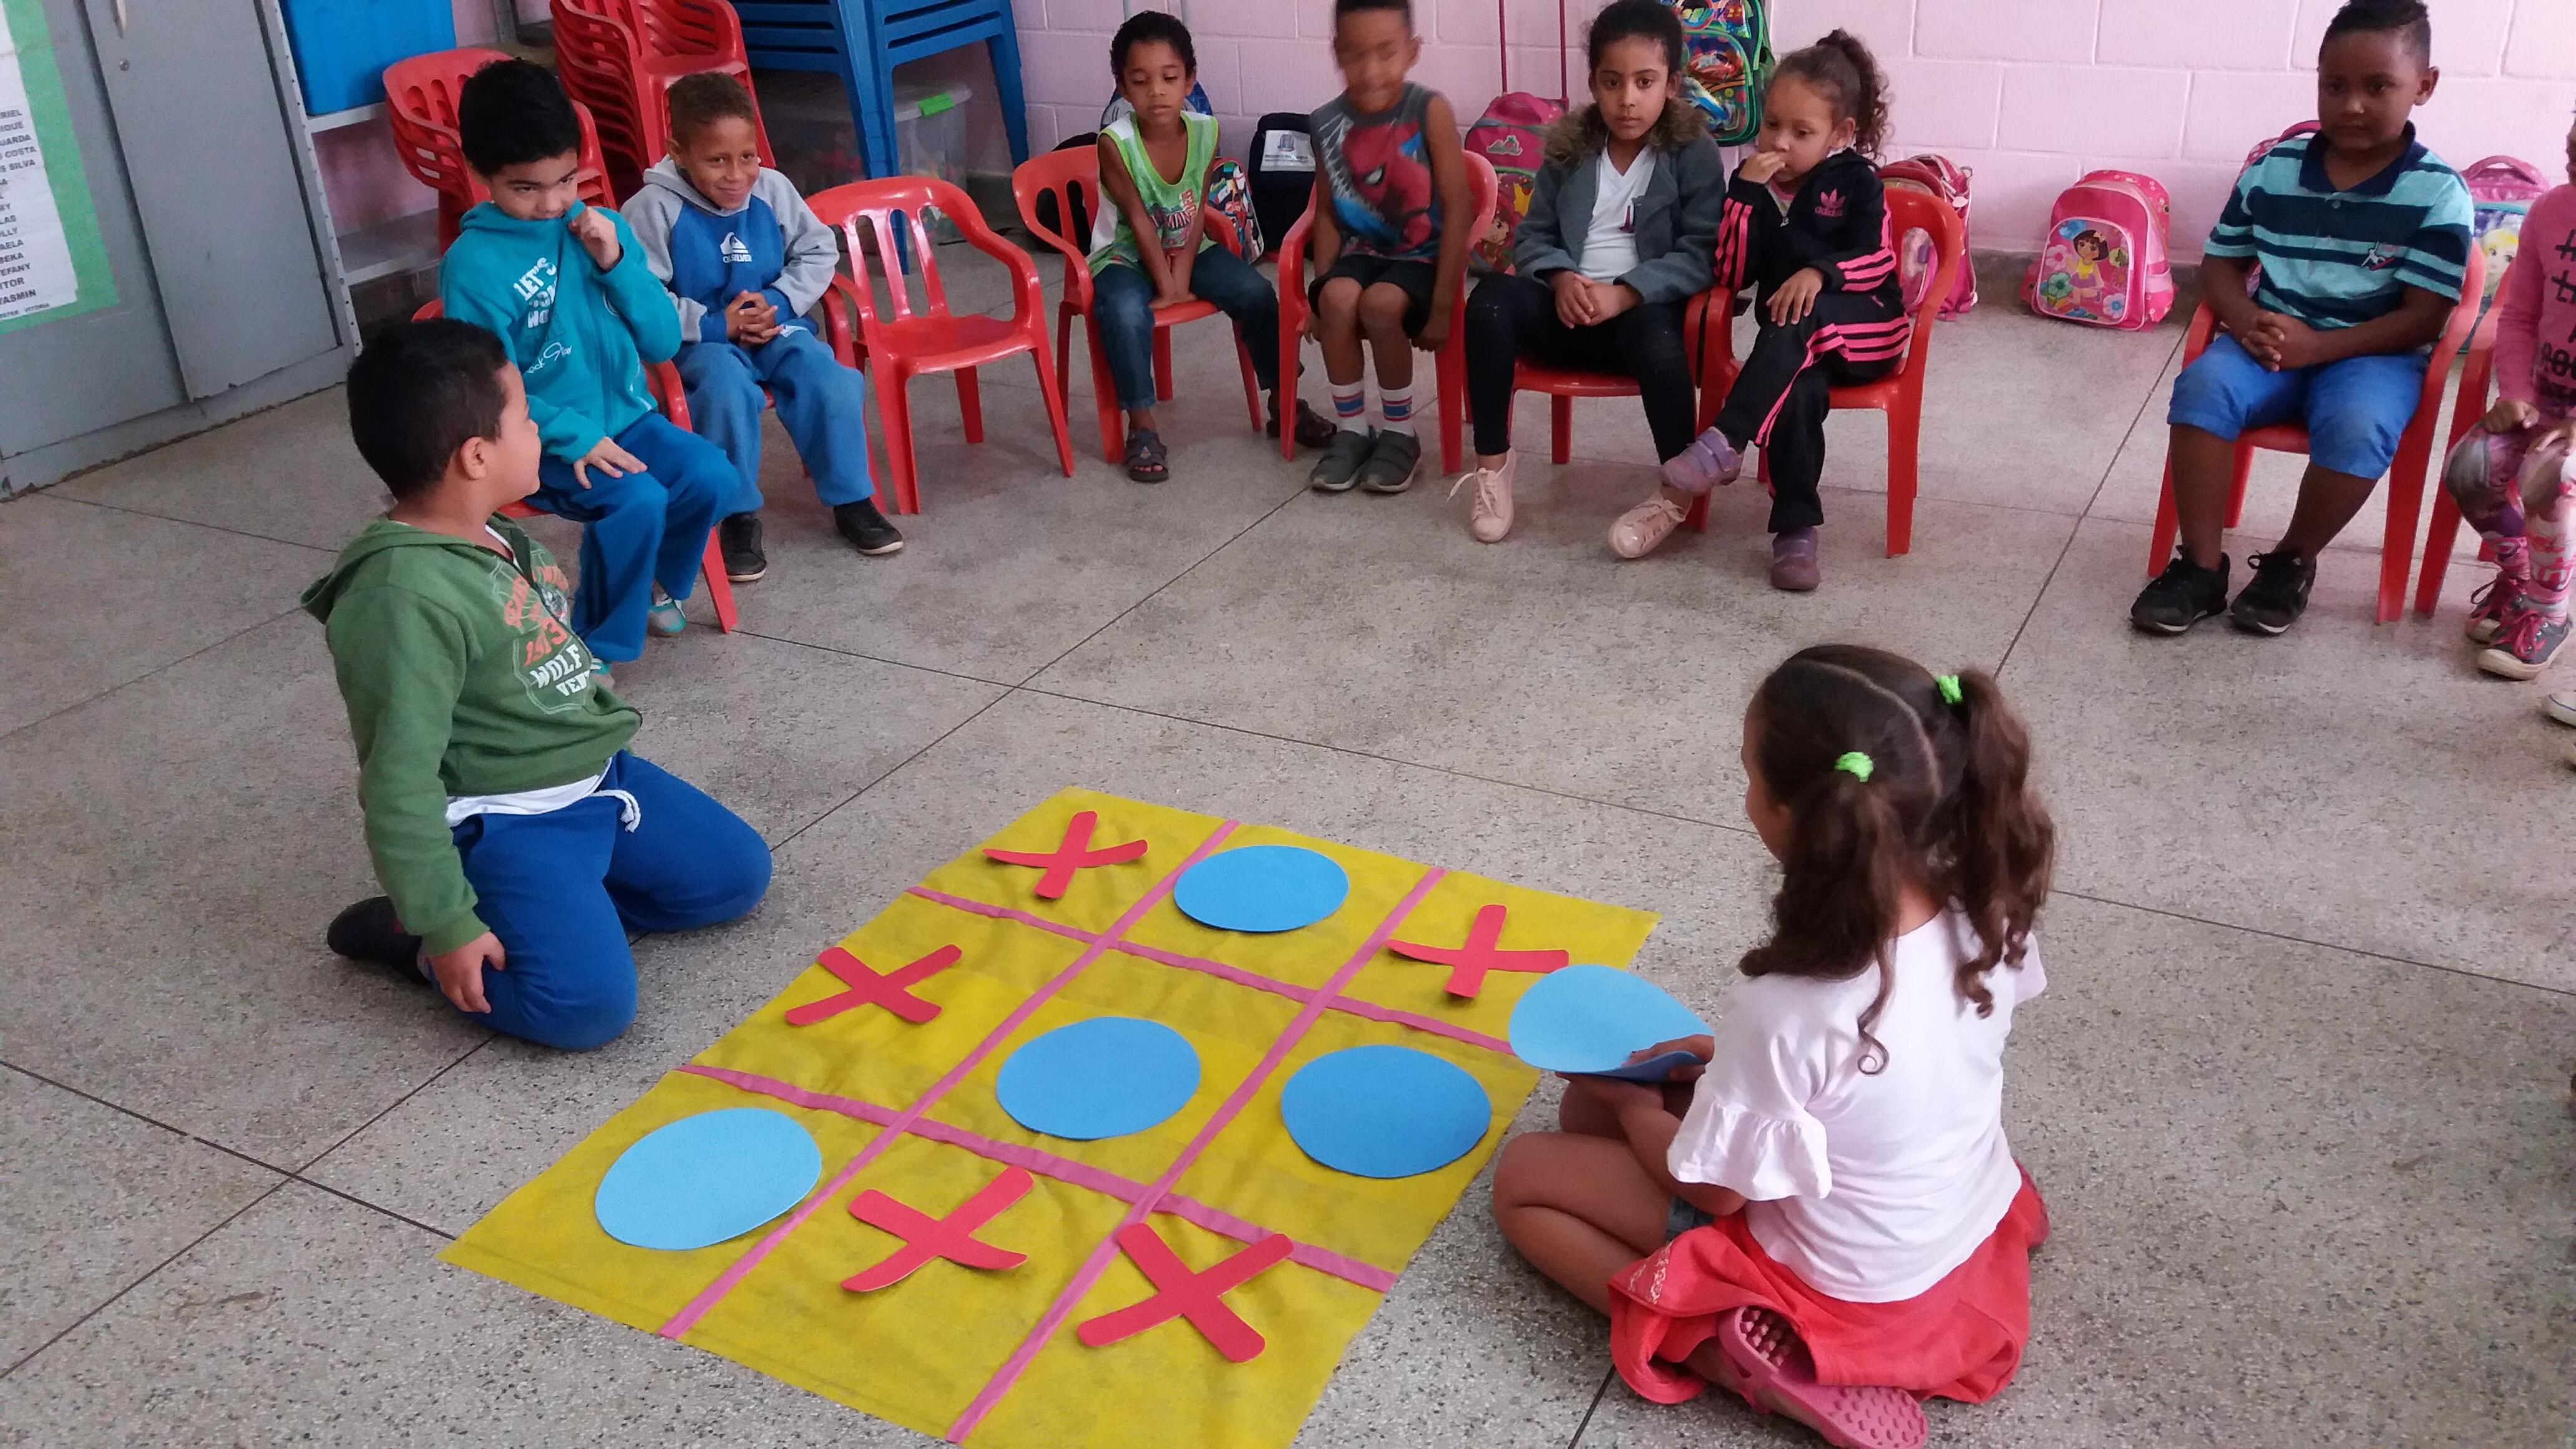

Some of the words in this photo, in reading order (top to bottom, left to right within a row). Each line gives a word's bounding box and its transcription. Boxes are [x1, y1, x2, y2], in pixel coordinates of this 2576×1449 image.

[5, 146, 36, 158] COSTA
[9, 159, 36, 170] SILVA
[513, 257, 557, 301] LET'S
[530, 643, 582, 689] WOLF
